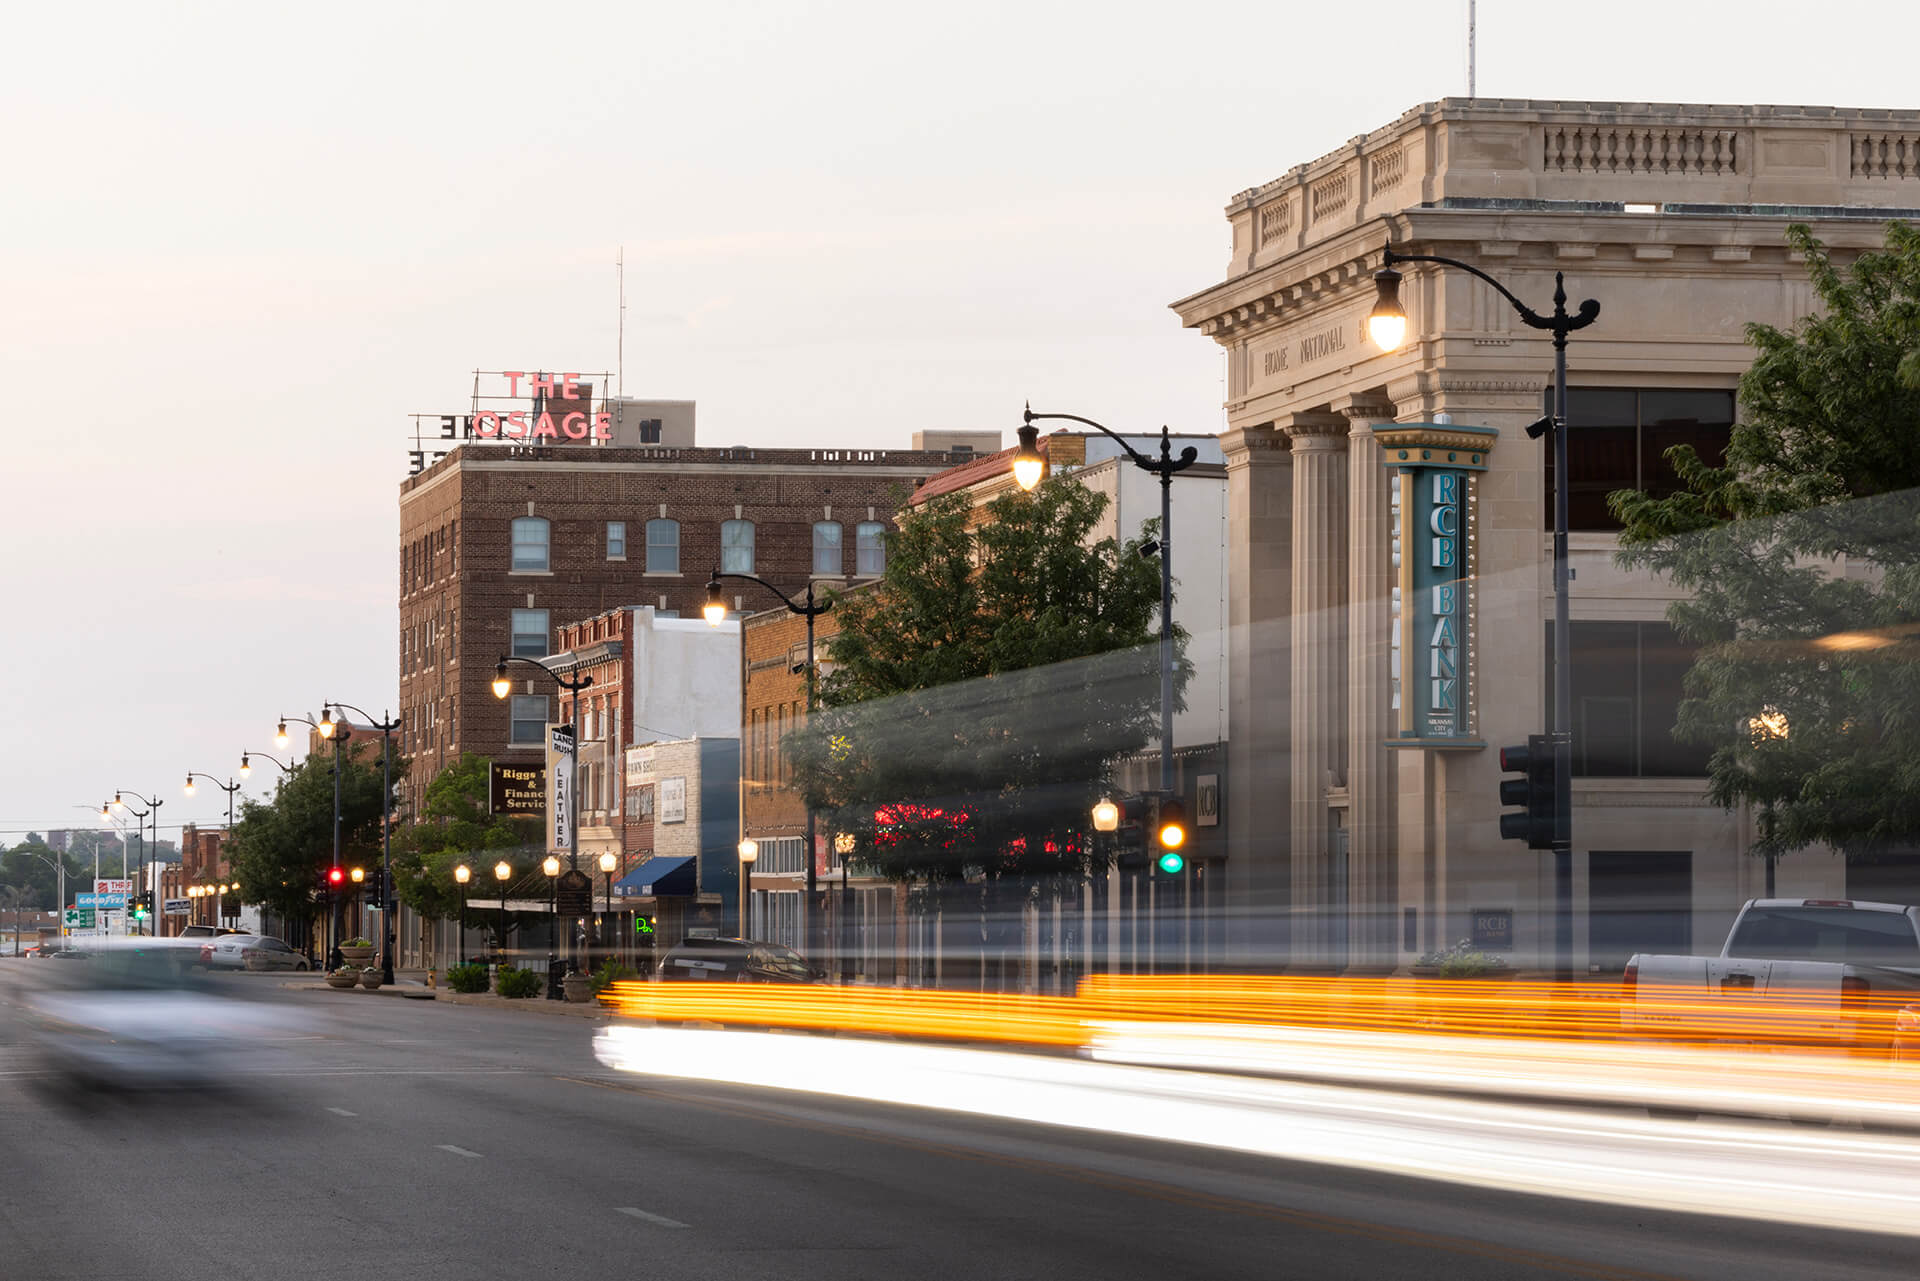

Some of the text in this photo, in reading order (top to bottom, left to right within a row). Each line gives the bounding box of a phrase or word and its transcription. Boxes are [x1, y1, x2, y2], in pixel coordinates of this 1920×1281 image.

[1264, 346, 1289, 377] HOME
[1300, 325, 1345, 364] NATIONAL
[504, 371, 580, 400] THE
[472, 410, 612, 439] OSAGE
[1430, 474, 1457, 567] RCB
[1430, 585, 1457, 709] BANK
[553, 732, 573, 746] LAND
[554, 743, 573, 755] RUSH
[503, 769, 536, 780] Riggs
[527, 781, 536, 789] &
[505, 789, 547, 798] Financ
[1198, 785, 1216, 816] RCB
[79, 894, 131, 906] GOODYEA
[1478, 917, 1507, 930] RCB
